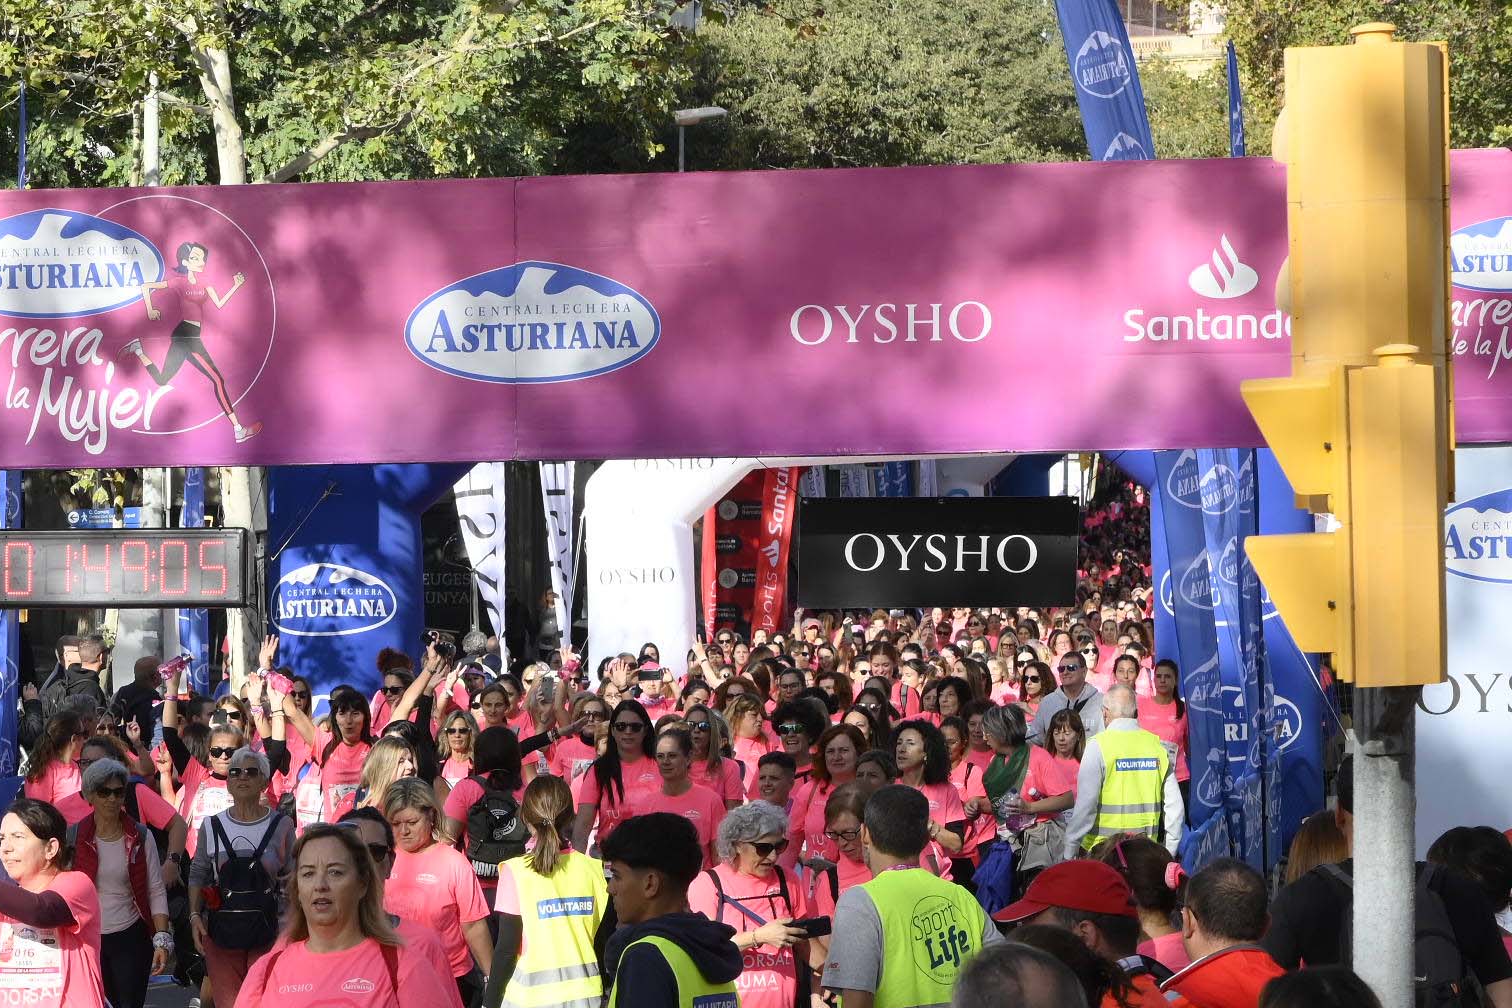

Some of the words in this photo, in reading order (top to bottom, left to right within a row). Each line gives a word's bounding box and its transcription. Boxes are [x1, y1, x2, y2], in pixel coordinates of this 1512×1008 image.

[464, 305, 541, 317] CENTRAL
[549, 302, 633, 315] LECHERA
[790, 301, 992, 346] OYSHO
[425, 310, 640, 355] ASTURIANA
[5, 370, 30, 409] la
[25, 361, 174, 455] Mujer
[844, 533, 1038, 574] OYSHO
[600, 566, 675, 585] OYSHO
[275, 594, 387, 620] ASTURIANA
[287, 589, 330, 598] CENTRAL
[913, 902, 956, 940] Sport
[743, 953, 791, 968] ORSAL
[925, 925, 969, 969] Life
[279, 983, 313, 993] OYSHO
